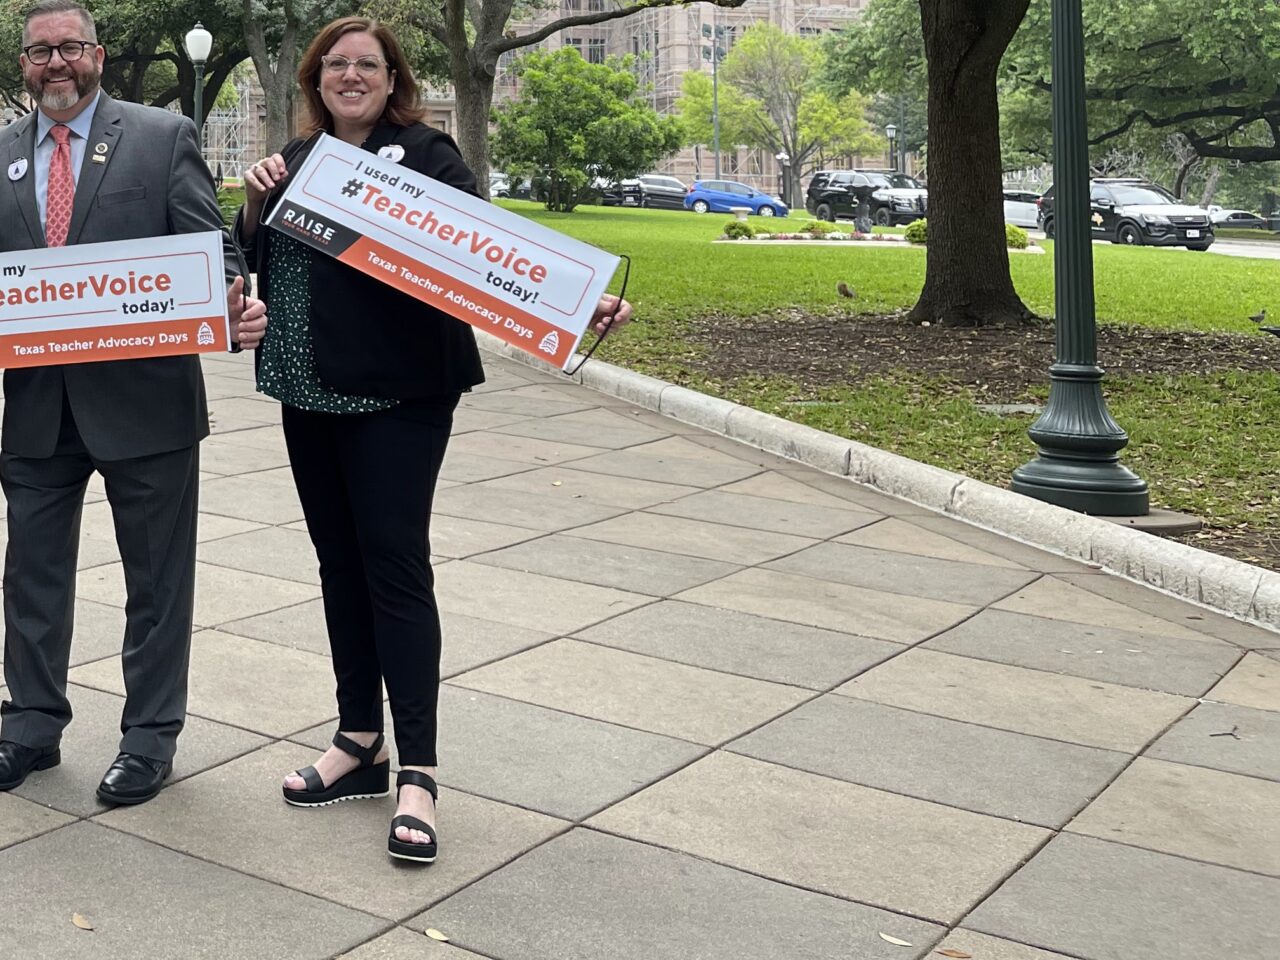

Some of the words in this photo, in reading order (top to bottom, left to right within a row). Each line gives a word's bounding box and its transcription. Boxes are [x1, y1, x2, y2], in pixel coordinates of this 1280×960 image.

[355, 161, 363, 171] I
[364, 165, 401, 187] used
[400, 183, 426, 199] my
[283, 209, 336, 241] RAISE
[341, 178, 548, 284] #TeacherVoice
[3, 265, 26, 277] my
[368, 251, 398, 273] Texas
[400, 266, 444, 295] Teacher
[445, 290, 503, 324] Advocacy
[504, 317, 534, 339] Days
[486, 271, 540, 304] today!
[122, 298, 175, 314] today!
[13, 344, 45, 356] Texas
[48, 340, 93, 353] Teacher
[97, 335, 155, 348] Advocacy
[159, 332, 188, 345] Days
